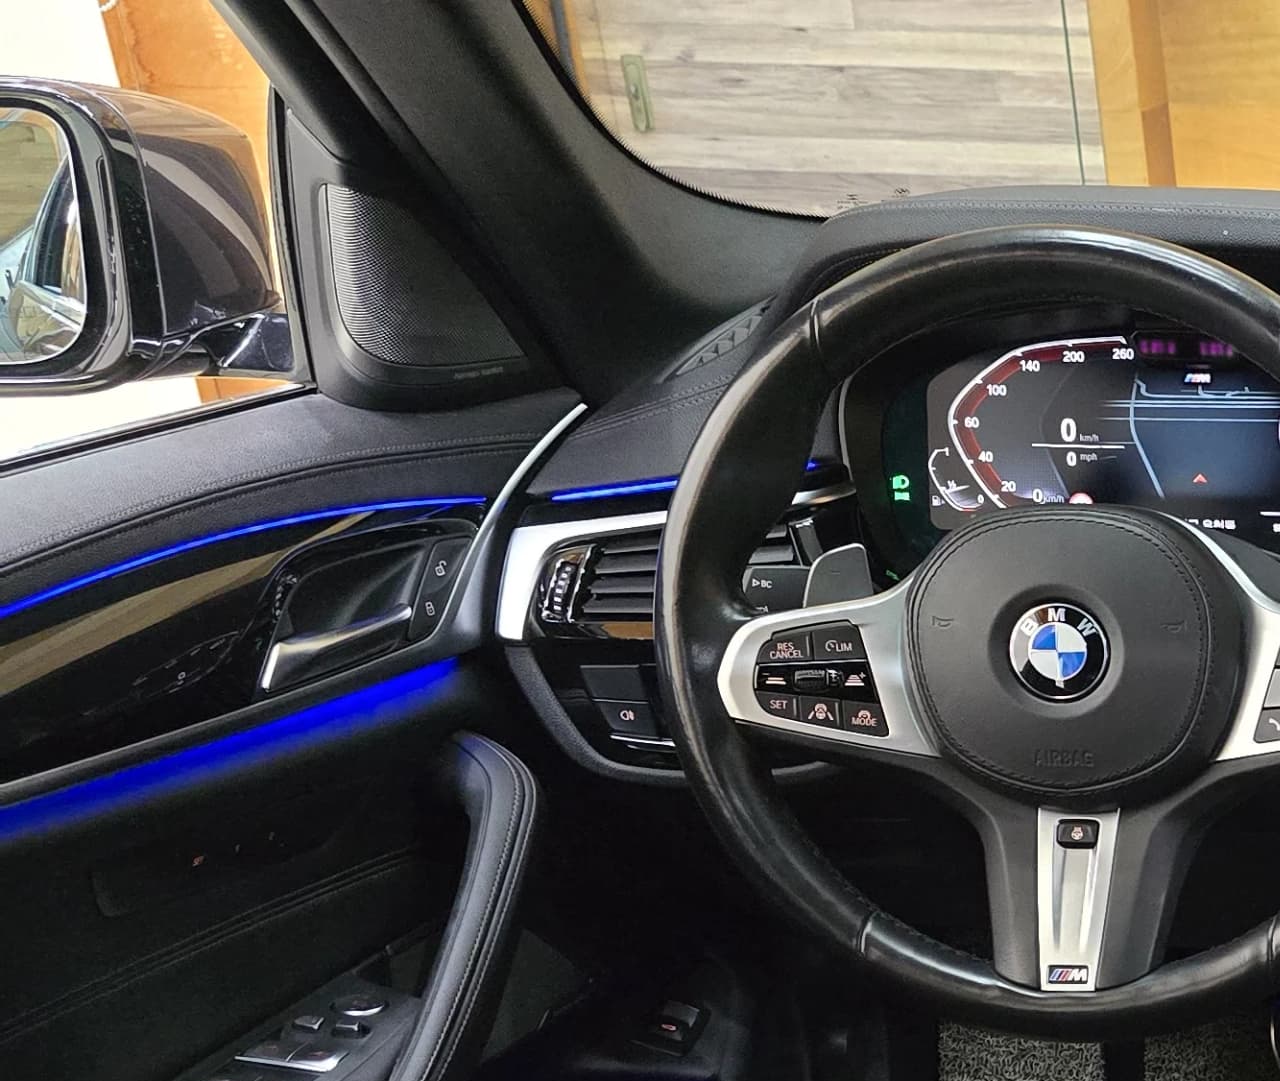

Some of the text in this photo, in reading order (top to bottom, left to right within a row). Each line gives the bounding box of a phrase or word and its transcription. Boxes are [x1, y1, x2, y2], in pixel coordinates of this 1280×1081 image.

[1062, 351, 1085, 363] 200
[1112, 348, 1135, 360] 260
[1019, 360, 1040, 372] 140
[986, 384, 1007, 396] 100
[964, 416, 980, 428] 60
[1060, 418, 1100, 443] 0 km/h
[978, 451, 994, 463] 40
[1066, 451, 1098, 466] 0 mph
[1001, 480, 1016, 492] 20
[977, 496, 985, 504] 0
[1032, 488, 1043, 503] 0
[1020, 607, 1097, 637] BMW
[776, 642, 795, 651] RES
[835, 642, 853, 652] LIM
[769, 649, 804, 660] CANCEL
[769, 699, 788, 710] SET
[851, 716, 878, 727] MODE
